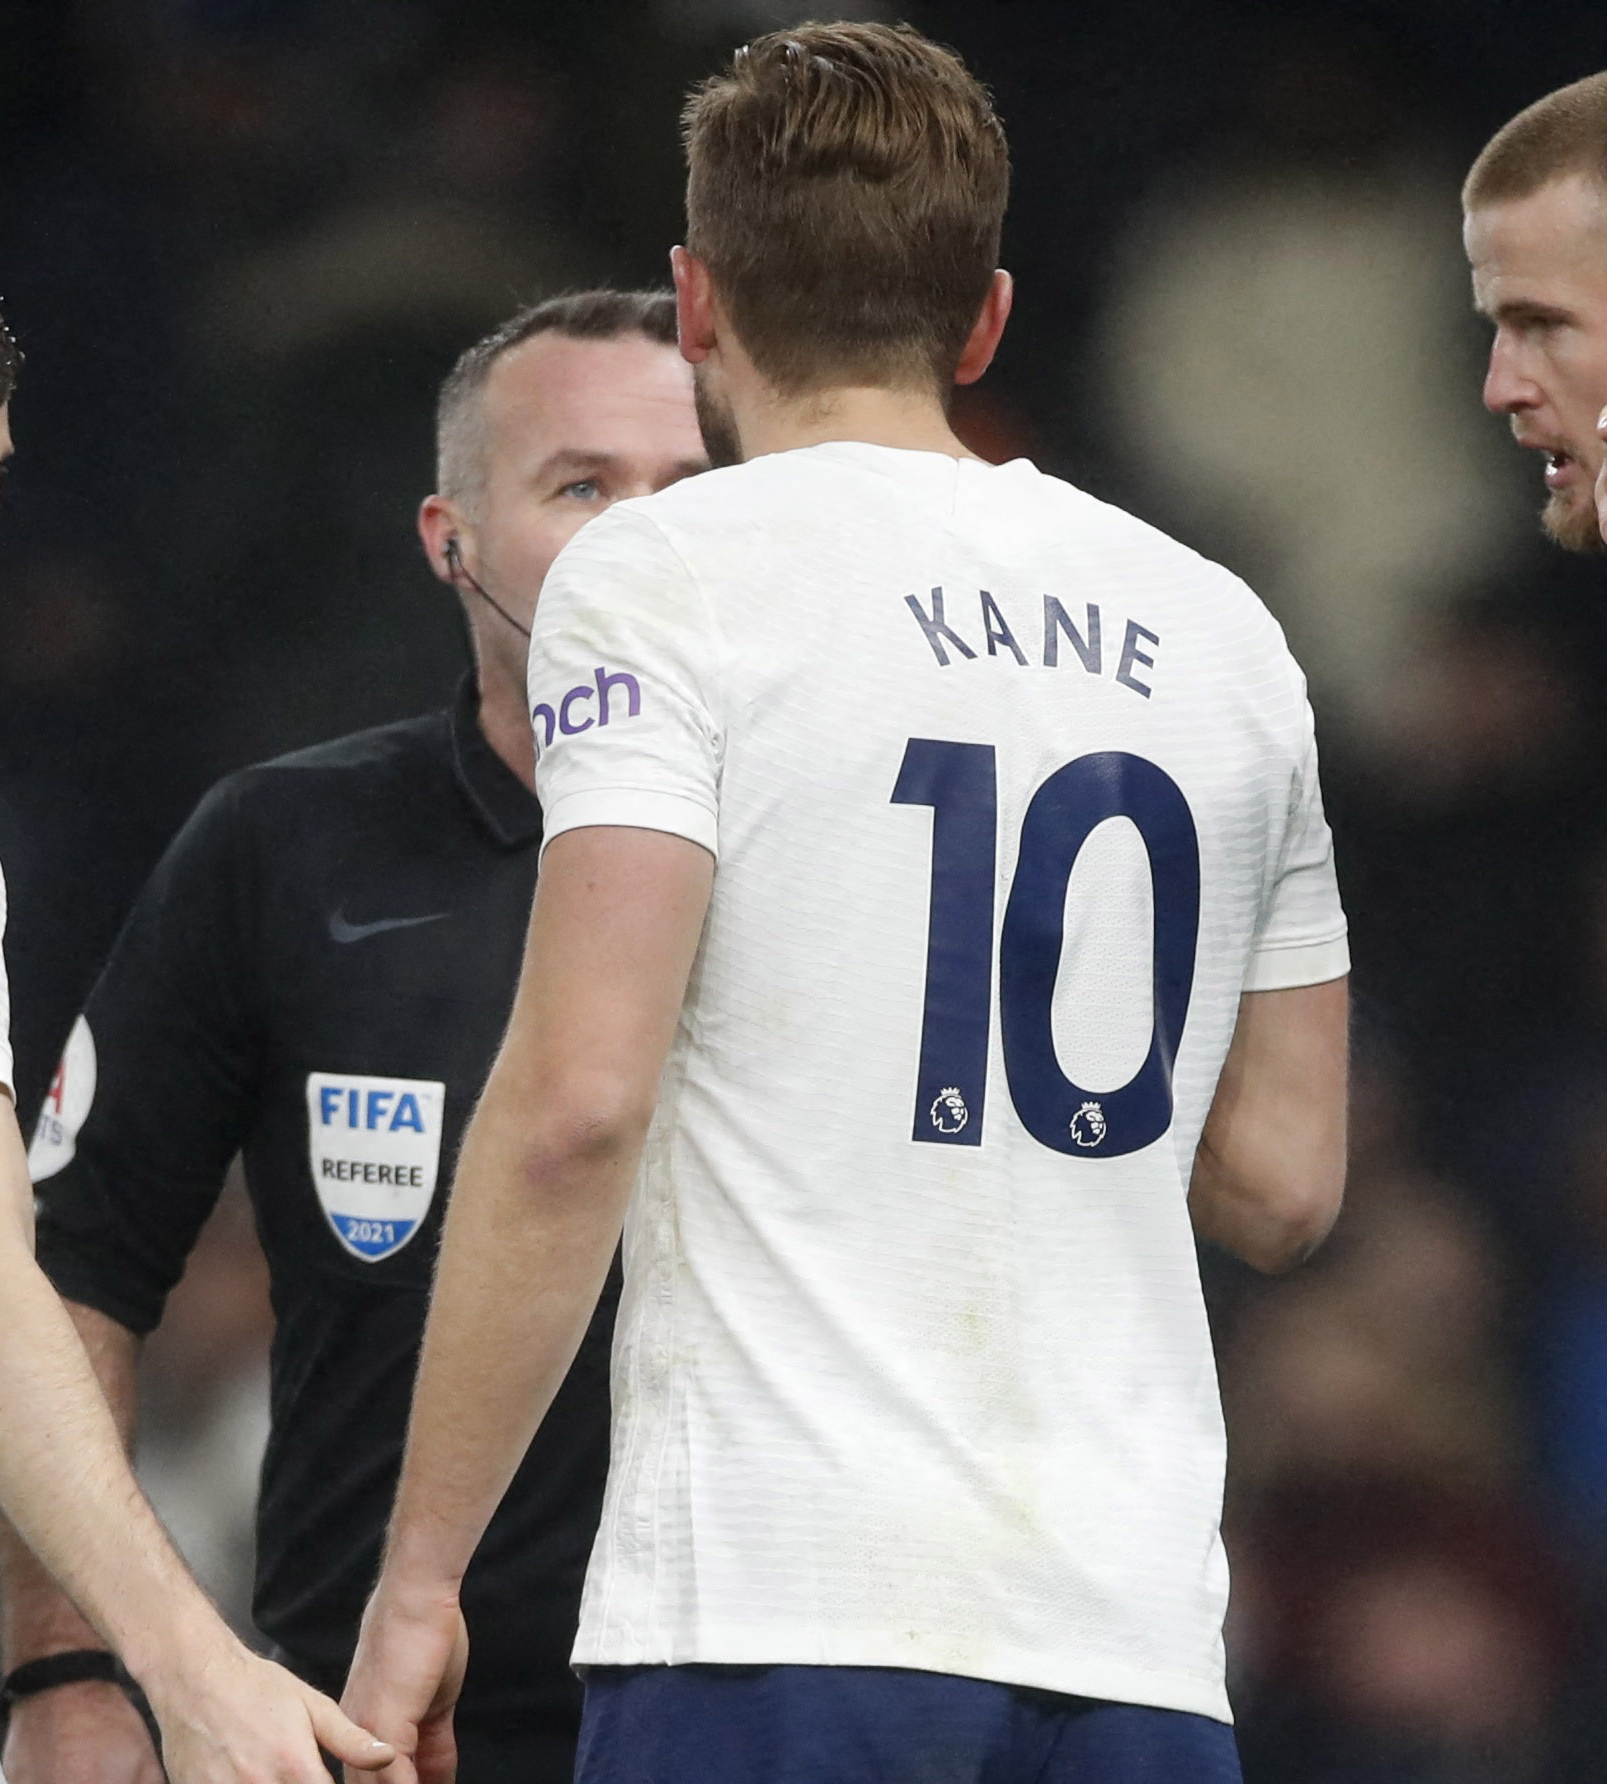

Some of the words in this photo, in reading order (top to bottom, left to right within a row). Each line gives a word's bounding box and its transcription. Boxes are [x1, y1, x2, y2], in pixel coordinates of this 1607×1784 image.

[904, 586, 1160, 699] KANE
[890, 738, 1201, 1160] 10
[320, 1087, 425, 1133] FIFA
[322, 1158, 424, 1188] REFEREE
[348, 1219, 395, 1244] 2021
